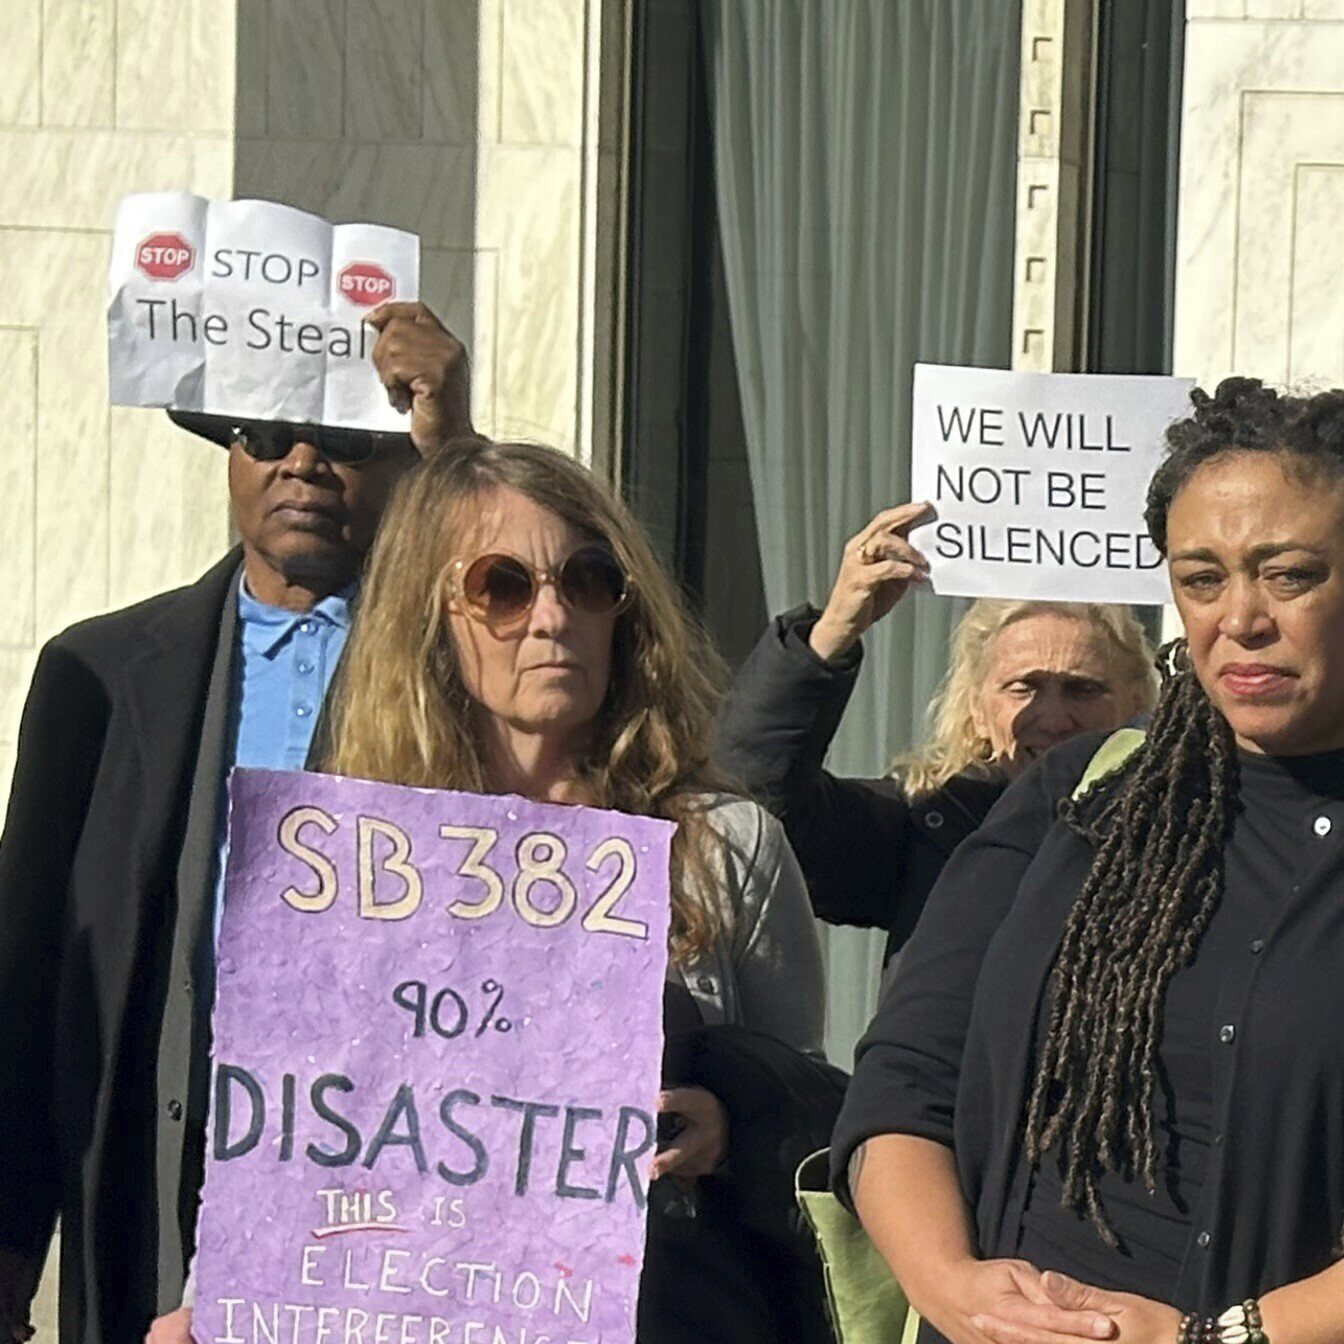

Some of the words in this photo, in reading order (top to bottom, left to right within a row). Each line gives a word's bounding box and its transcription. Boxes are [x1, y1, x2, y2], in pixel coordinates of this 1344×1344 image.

[140, 247, 190, 266] STOP
[212, 250, 319, 286] STOP
[341, 277, 390, 293] STOP
[136, 299, 227, 345] The
[247, 309, 366, 359] Steal
[937, 405, 1003, 446] WE
[1018, 411, 1131, 451] WILL
[936, 465, 1030, 505] NOT
[1048, 471, 1106, 510] BE
[936, 523, 1163, 570] SILENCED
[278, 806, 423, 920] SB
[439, 826, 648, 939] 382
[392, 979, 512, 1038] 90%
[213, 1064, 657, 1216] DISASTER
[317, 1189, 397, 1225] THIS
[430, 1196, 466, 1227] IS
[301, 1245, 593, 1322] ELECTION
